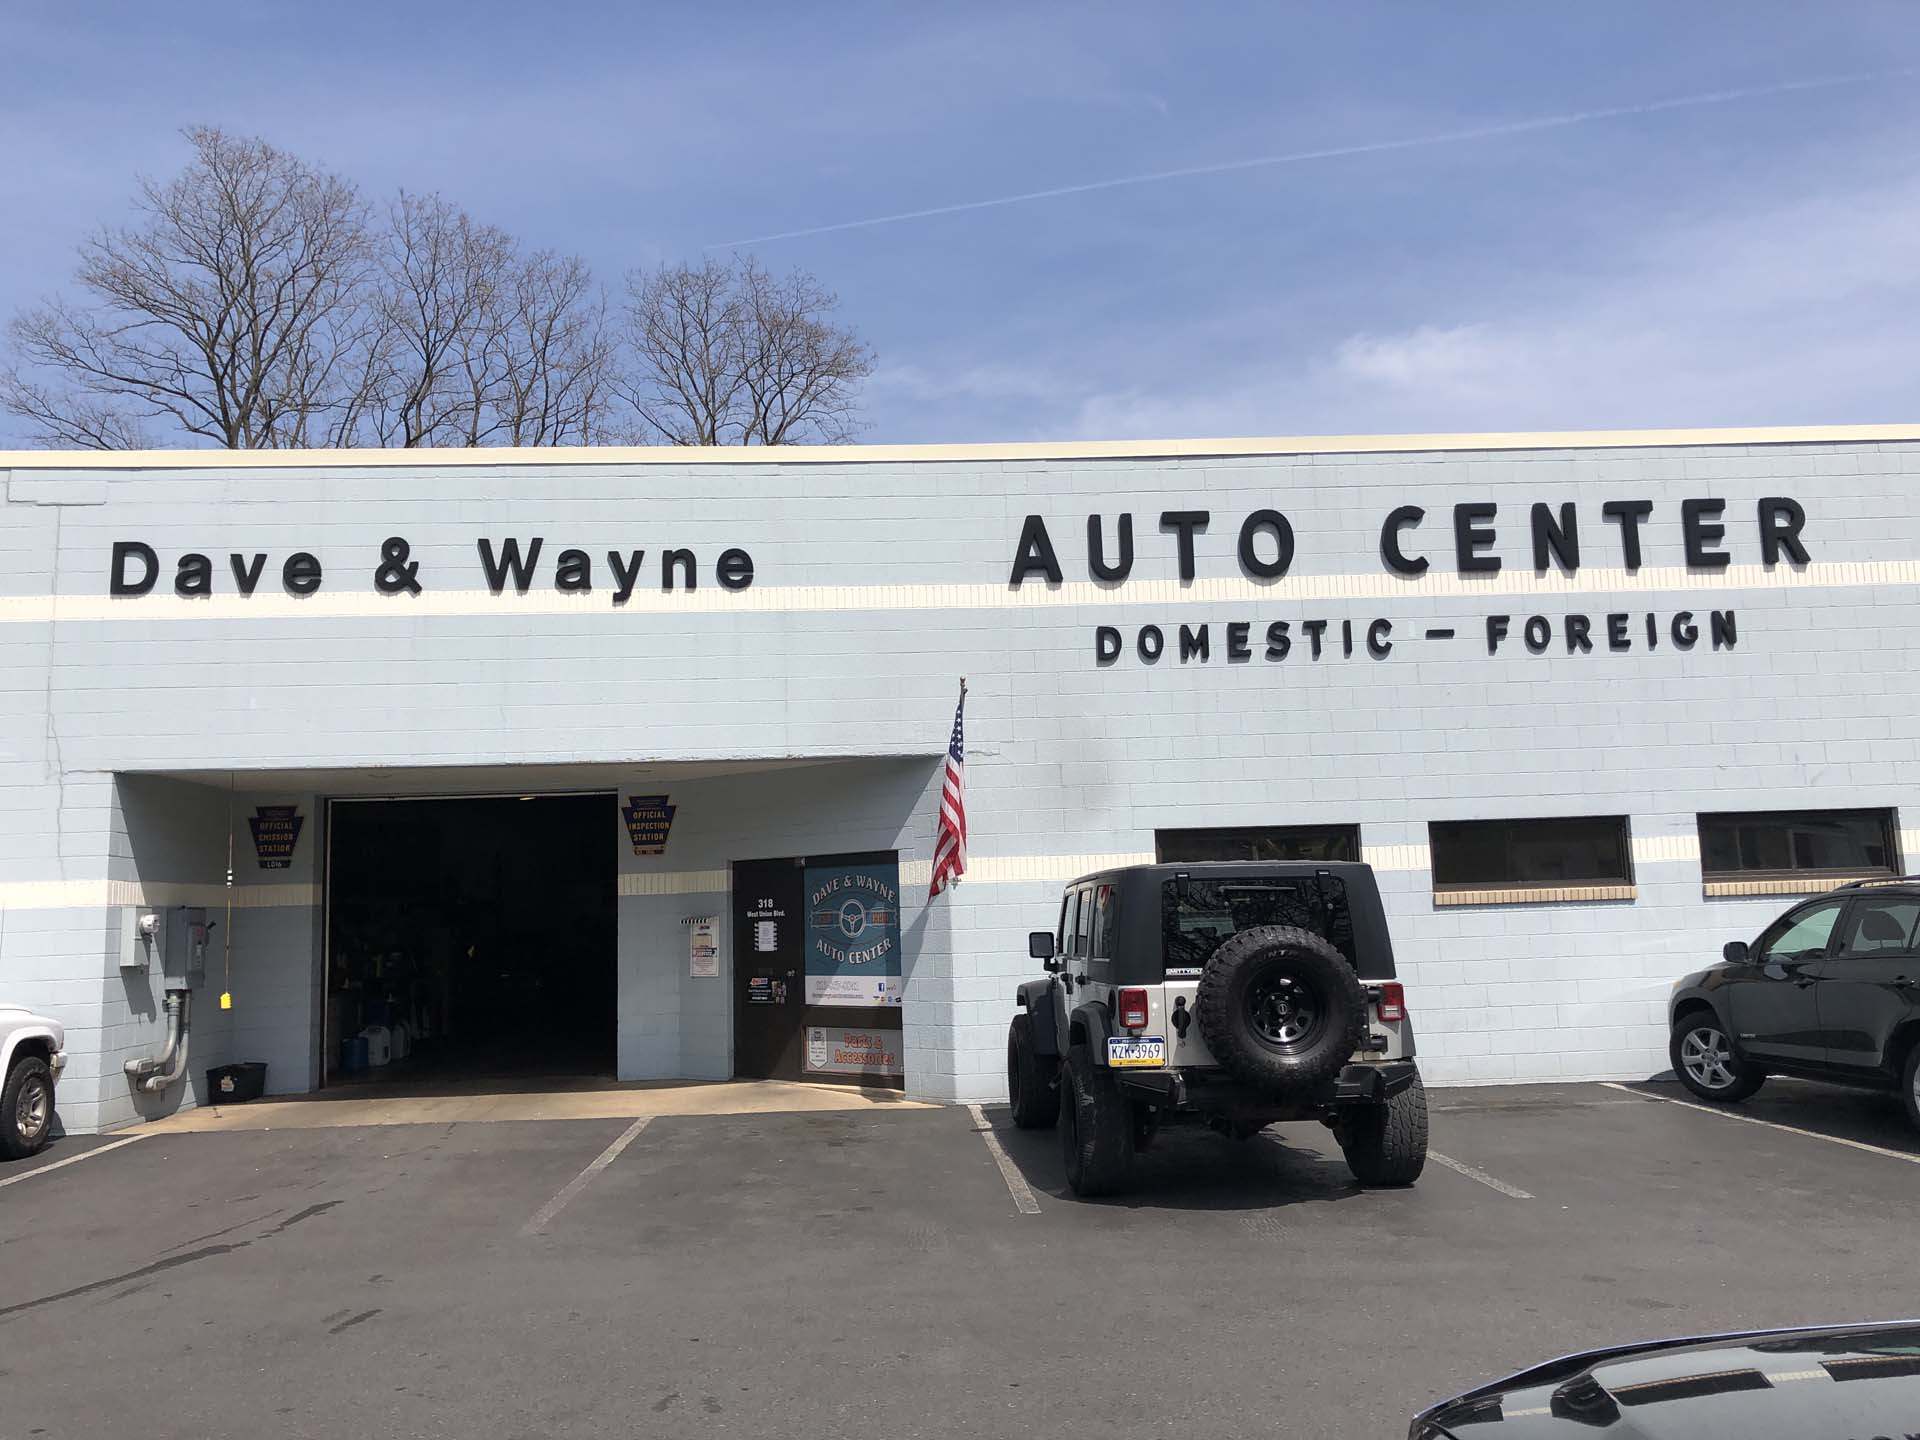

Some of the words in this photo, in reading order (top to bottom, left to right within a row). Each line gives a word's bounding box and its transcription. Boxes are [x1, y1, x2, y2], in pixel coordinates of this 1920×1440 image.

[1009, 509, 1295, 586] AUTO
[1380, 497, 1811, 576] CENTER
[111, 541, 322, 596] Dave
[374, 536, 423, 594] &
[477, 537, 754, 603] Wayne
[1096, 618, 1393, 663] DOMESTIC
[1486, 610, 1737, 653] FOREIGN
[632, 811, 666, 819] OFFICIAL
[629, 822, 670, 830] INSPECTION
[633, 833, 664, 841] STATION
[812, 878, 840, 906] DAVE
[843, 874, 852, 887] &
[856, 875, 896, 903] WAYNE
[758, 899, 774, 908] 318
[816, 938, 845, 962] AUTO
[848, 938, 892, 964] CENTER
[844, 1032, 872, 1049] Parts
[834, 1048, 896, 1065] Accessories
